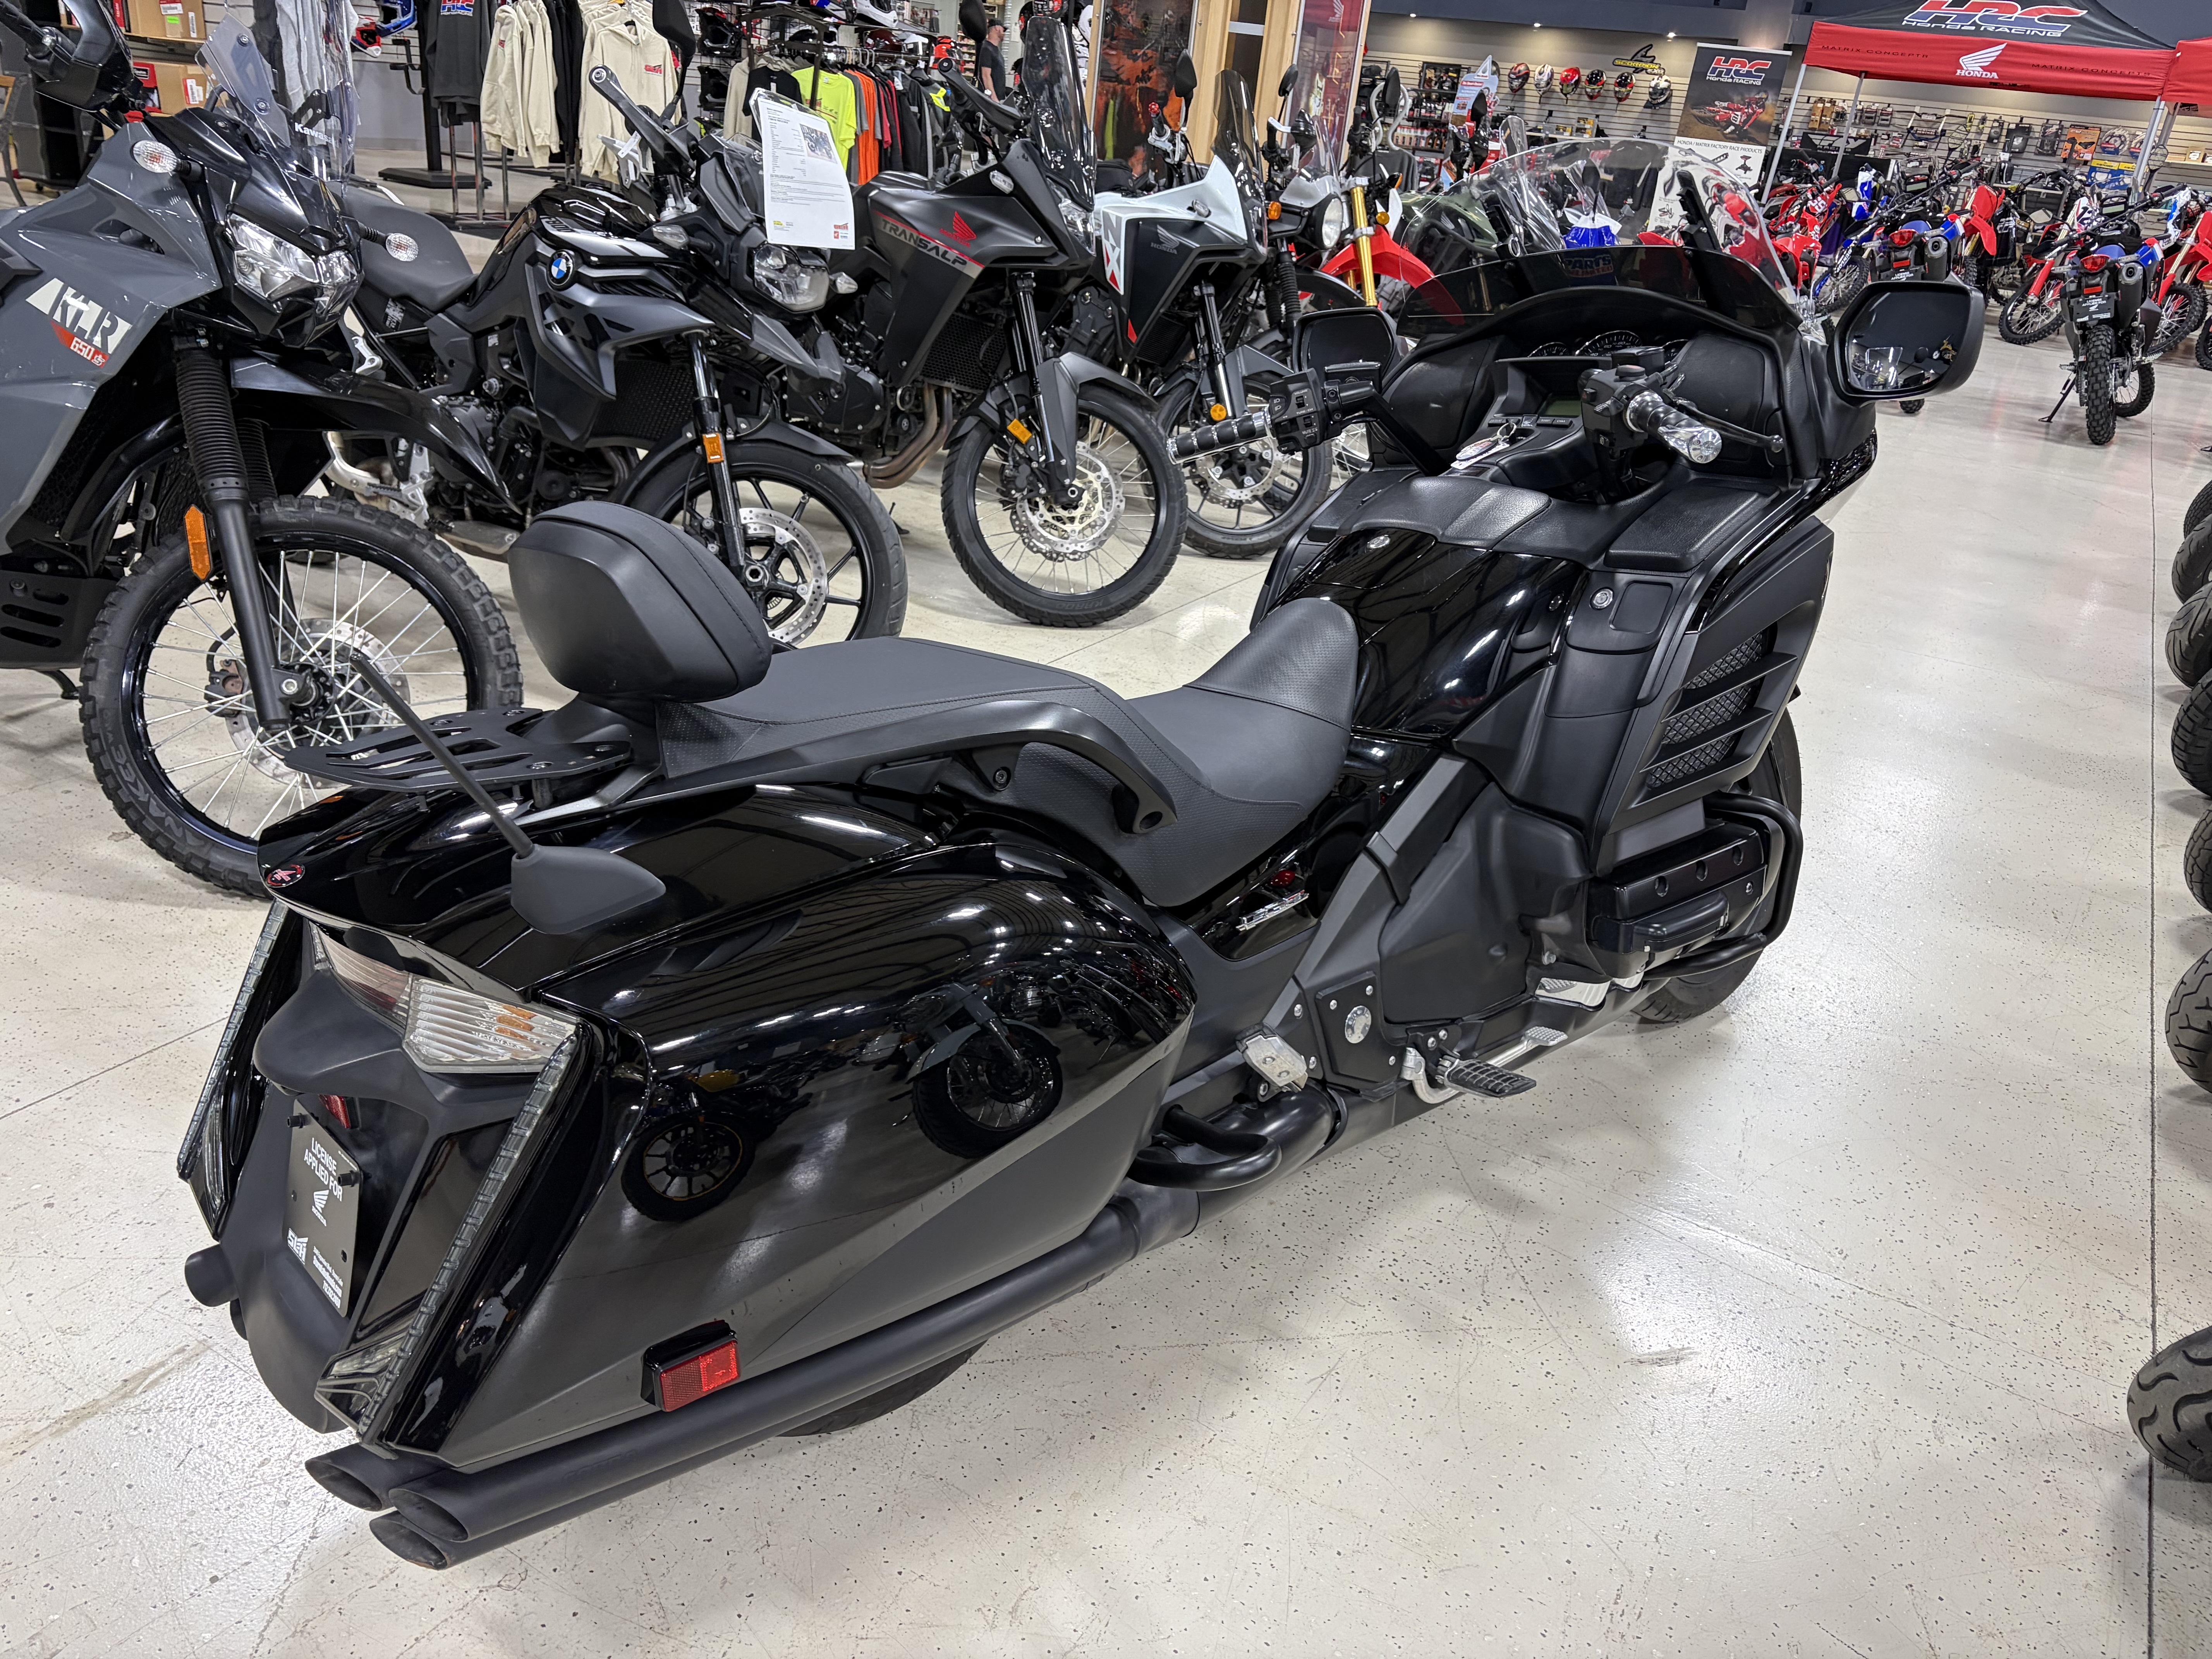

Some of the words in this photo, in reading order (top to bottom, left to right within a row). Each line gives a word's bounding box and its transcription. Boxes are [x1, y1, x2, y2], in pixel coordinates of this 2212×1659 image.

[1903, 0, 2088, 32] HRC
[1902, 21, 1976, 30] Honda
[1980, 26, 2064, 37] RACING
[1614, 60, 1660, 70] SCORPION
[1707, 56, 1772, 81] HRC
[1955, 69, 1999, 79] HONDA
[295, 122, 333, 144] Kawasa
[881, 218, 967, 266] TRANSALP
[1150, 242, 1178, 254] HONDA
[70, 337, 95, 361] 650
[311, 1137, 337, 1176] LICENSE
[304, 1149, 329, 1185] APPLIED
[329, 1175, 343, 1202] FOR
[311, 1205, 327, 1227] HONDA
